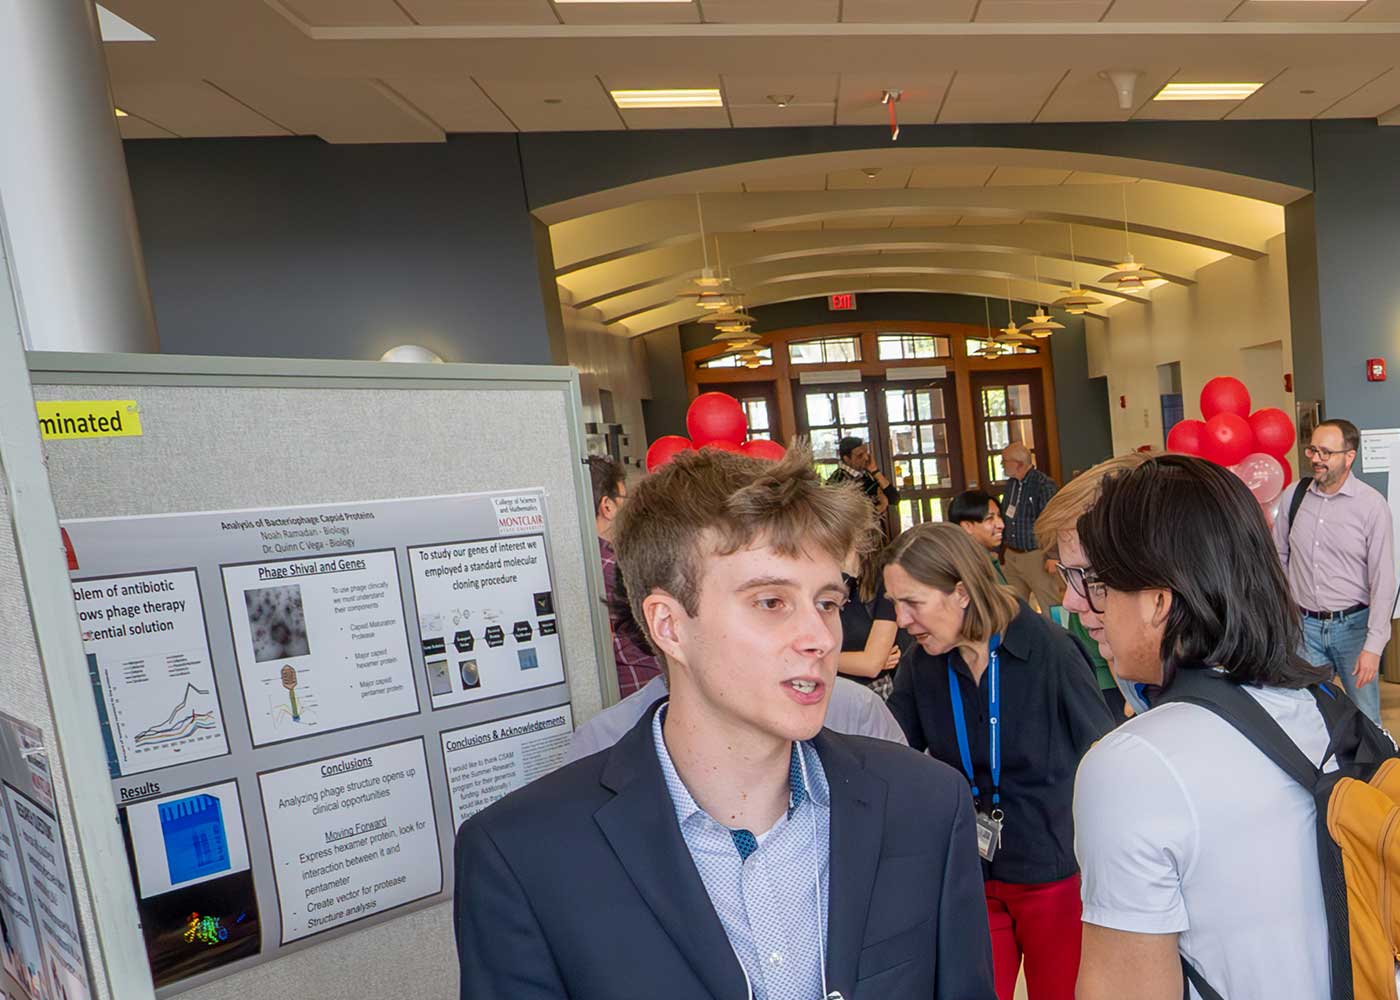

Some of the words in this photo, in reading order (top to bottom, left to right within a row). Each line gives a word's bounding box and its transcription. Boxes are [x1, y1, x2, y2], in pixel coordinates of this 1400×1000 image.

[832, 294, 852, 310] EXIT
[39, 410, 122, 434] minated
[221, 520, 253, 530] Analysis
[256, 519, 263, 528] of
[265, 515, 319, 527] Bacteriophage
[320, 513, 343, 523] Capsid
[345, 512, 375, 520] Proteins
[499, 515, 543, 527] MONTCLAIR
[419, 551, 429, 560] To
[431, 548, 450, 559] study
[453, 548, 465, 557] our
[468, 546, 488, 558] genes
[490, 544, 497, 553] of
[499, 542, 526, 552] interest
[527, 540, 537, 549] we
[258, 568, 287, 579] Phage
[320, 562, 336, 572] and
[338, 558, 365, 570] Genes
[425, 564, 462, 577] employed
[464, 564, 468, 572] a
[470, 560, 502, 571] standard
[504, 556, 537, 567] molecular
[107, 584, 118, 597] of
[121, 579, 174, 595] antibiotic
[453, 578, 479, 590] cloning
[482, 574, 517, 588] procedure
[107, 605, 140, 620] phage
[143, 599, 185, 618] therapy
[130, 620, 174, 636] solution
[446, 734, 491, 751] Conclusions
[492, 731, 498, 739] &
[321, 756, 373, 776] Conclusions
[120, 782, 160, 799] Results
[279, 791, 318, 809] Analyzing
[320, 785, 344, 801] phage
[347, 777, 380, 792] structure
[382, 770, 404, 784] opens
[406, 768, 415, 778] up
[312, 801, 339, 815] clinical
[341, 789, 391, 809] opportunities
[325, 828, 354, 841] Moving
[356, 817, 387, 834] Forward
[300, 848, 332, 864] Express
[334, 837, 367, 854] hexamer
[399, 823, 414, 834] look
[416, 821, 426, 830] for
[302, 862, 344, 881] interaction
[346, 851, 378, 868] between
[380, 847, 385, 857] it
[387, 844, 400, 854] and
[305, 876, 350, 898] pentameter
[307, 897, 334, 913] Create
[336, 890, 360, 903] vector
[362, 886, 372, 895] for
[374, 875, 406, 894] protease
[308, 909, 344, 929] Structure
[346, 900, 376, 917] analysis
